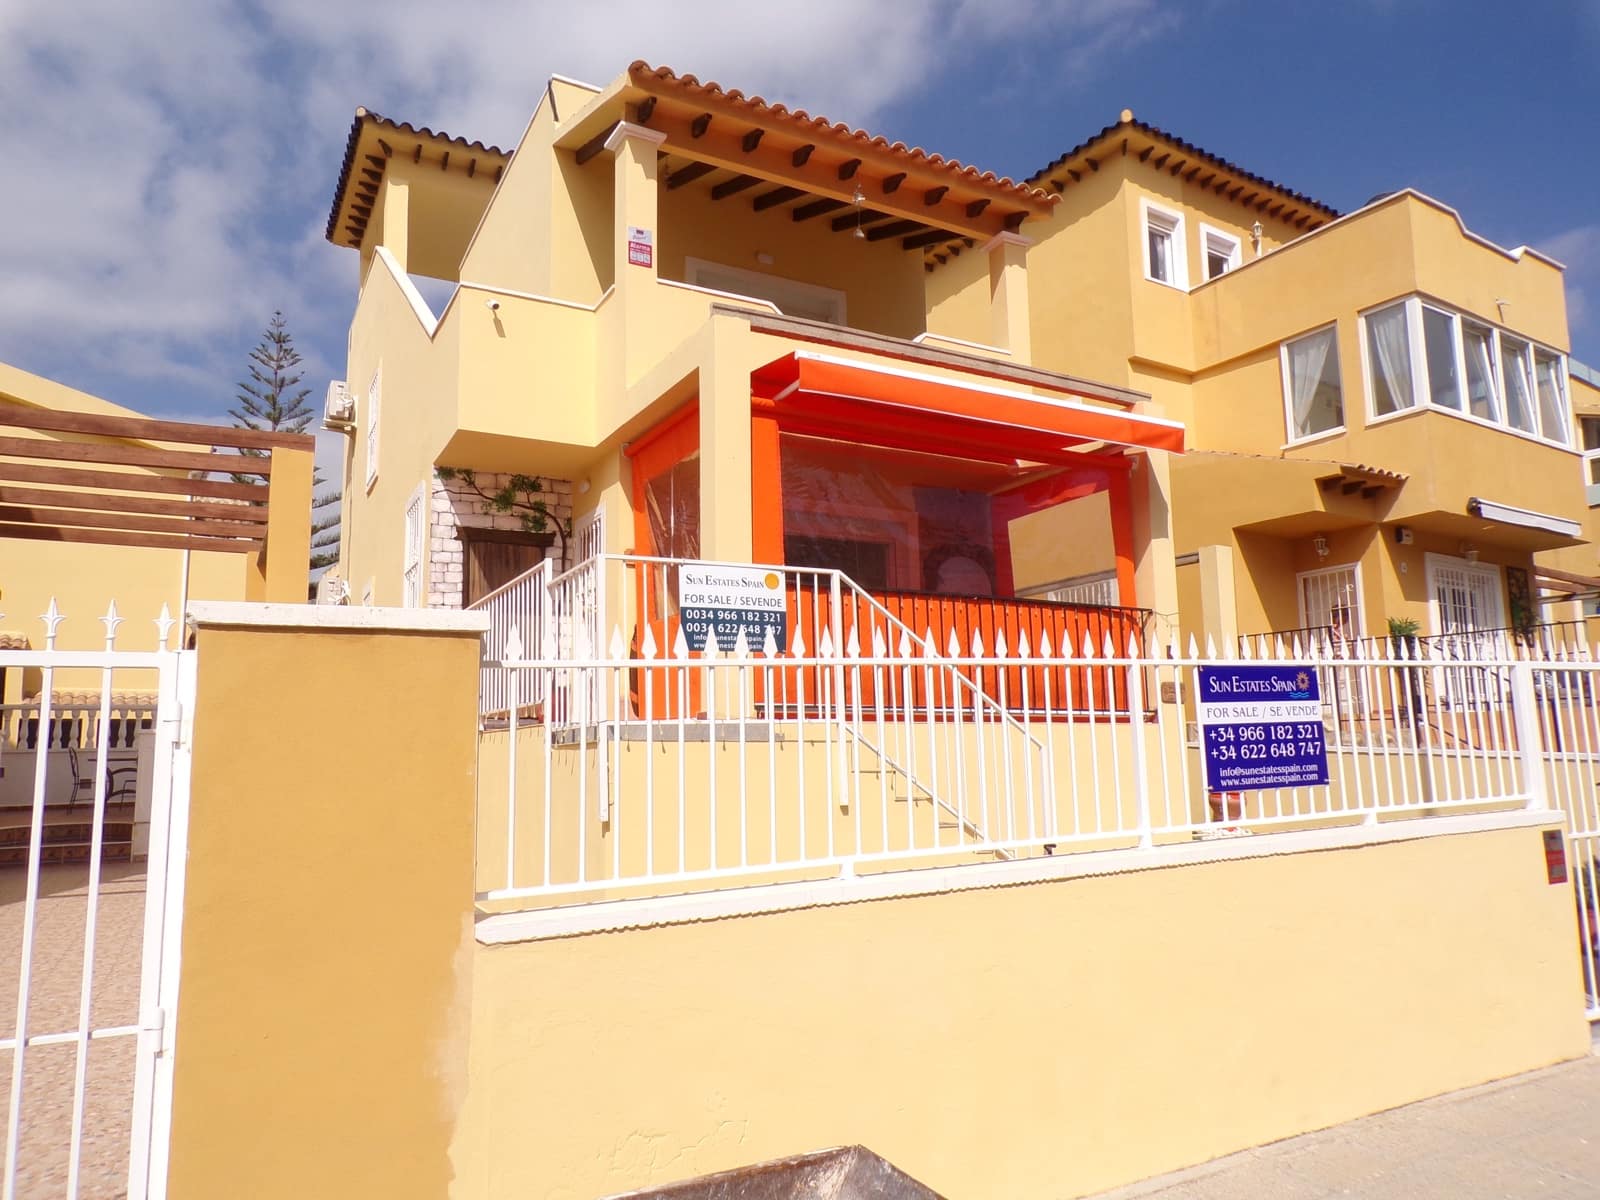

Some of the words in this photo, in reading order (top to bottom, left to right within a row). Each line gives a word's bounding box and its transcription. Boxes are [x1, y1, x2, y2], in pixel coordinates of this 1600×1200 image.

[684, 594, 704, 604] FOR
[708, 594, 732, 605] SALE
[740, 596, 782, 608] SEVENDE
[686, 610, 714, 620] 0034
[717, 611, 738, 620] 966
[741, 612, 760, 622] 182
[763, 613, 780, 622] 321
[686, 623, 714, 633] 003
[718, 624, 738, 633] 622
[1207, 707, 1230, 718] FOR
[1232, 707, 1258, 717] SALE
[1270, 706, 1282, 716] SE
[1285, 706, 1318, 716] VENDE
[1210, 727, 1235, 742] +34
[1238, 726, 1265, 741] 966
[1270, 725, 1293, 740] 182
[1297, 724, 1319, 739] 321
[1211, 745, 1237, 760] +34
[1240, 744, 1267, 759] 622
[1270, 743, 1295, 757] 648
[1299, 742, 1321, 756] 747
[1220, 763, 1318, 777] info@sunestatesspain.com
[1220, 773, 1318, 786] www.sunestatesspain.com
